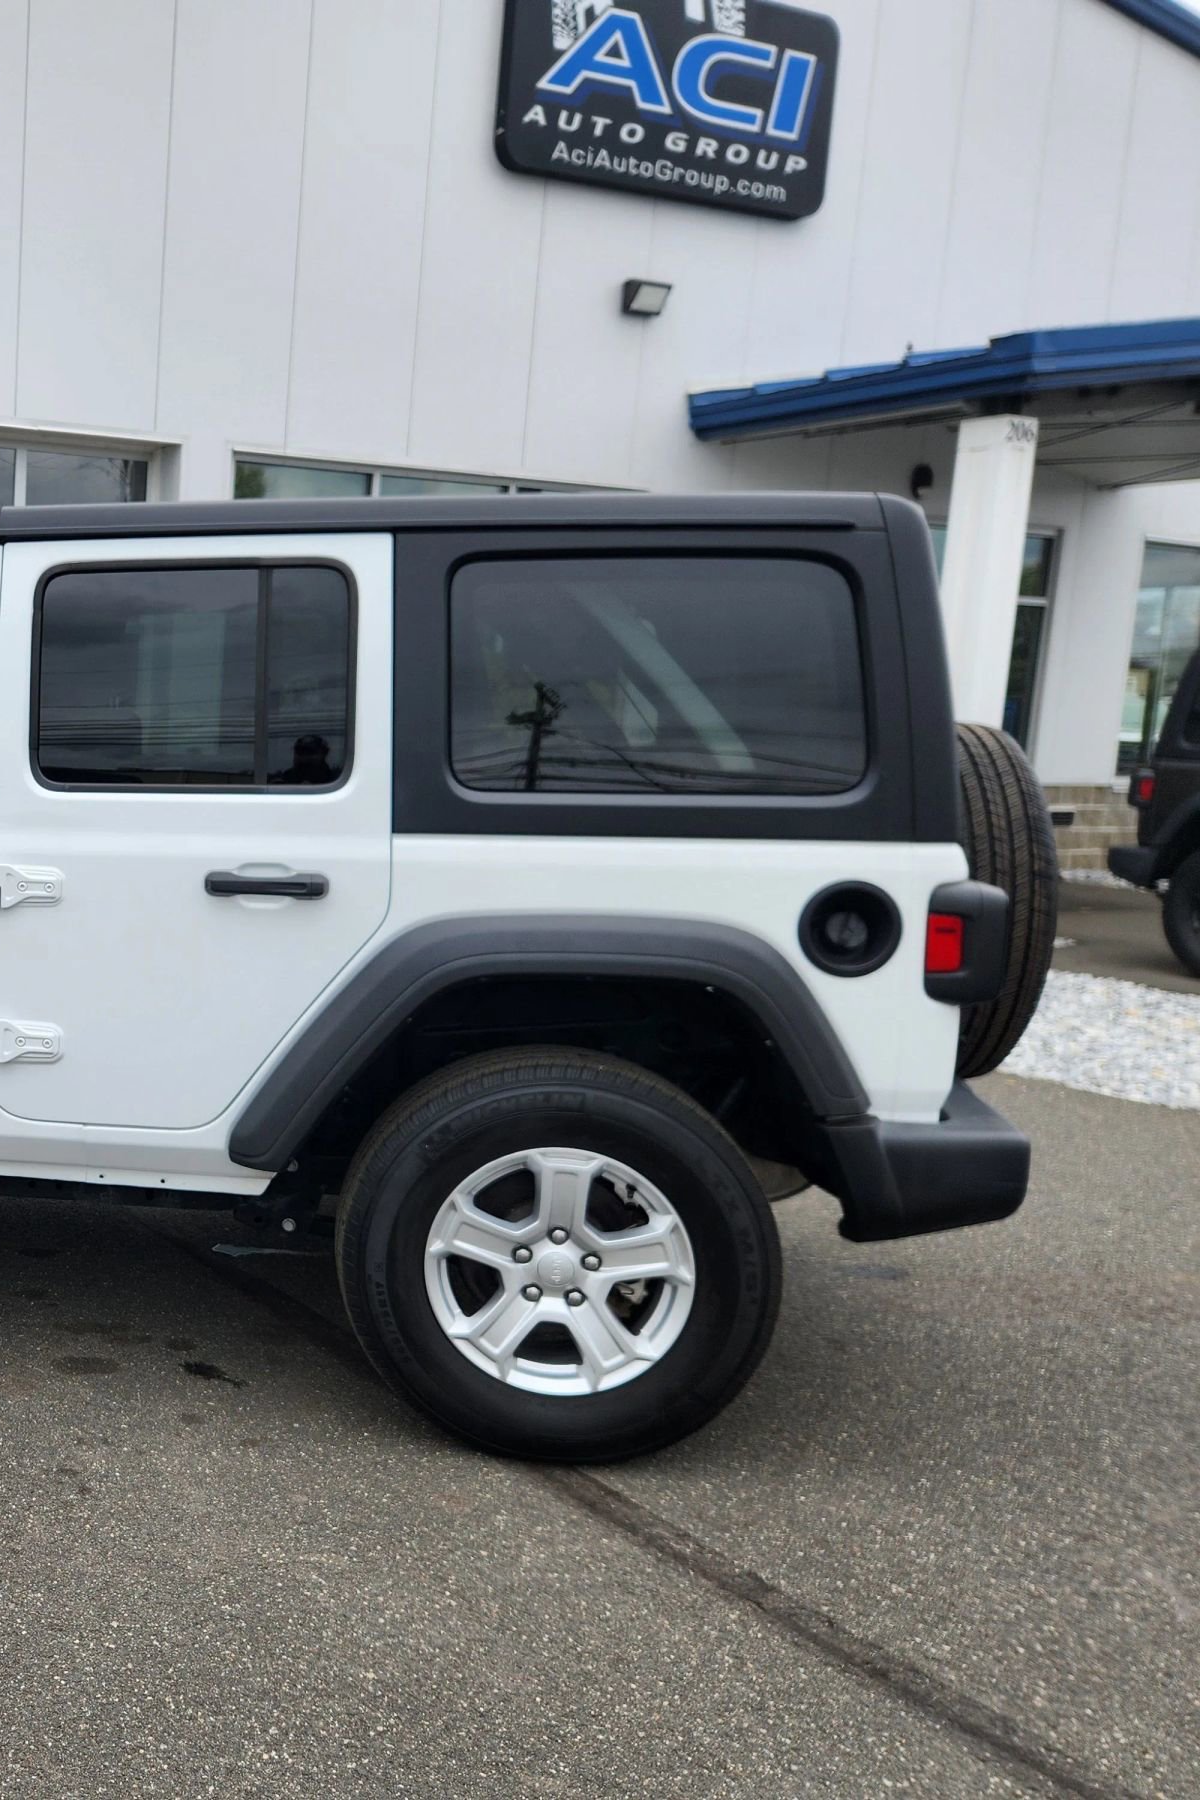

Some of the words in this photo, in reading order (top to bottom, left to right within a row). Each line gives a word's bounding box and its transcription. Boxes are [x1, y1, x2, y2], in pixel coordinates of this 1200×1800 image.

[536, 7, 817, 141] ACI
[522, 104, 646, 144] AUTO
[664, 132, 808, 174] GROUP
[551, 141, 788, 202] AciAutoGroup.com
[1004, 419, 1035, 442] 206
